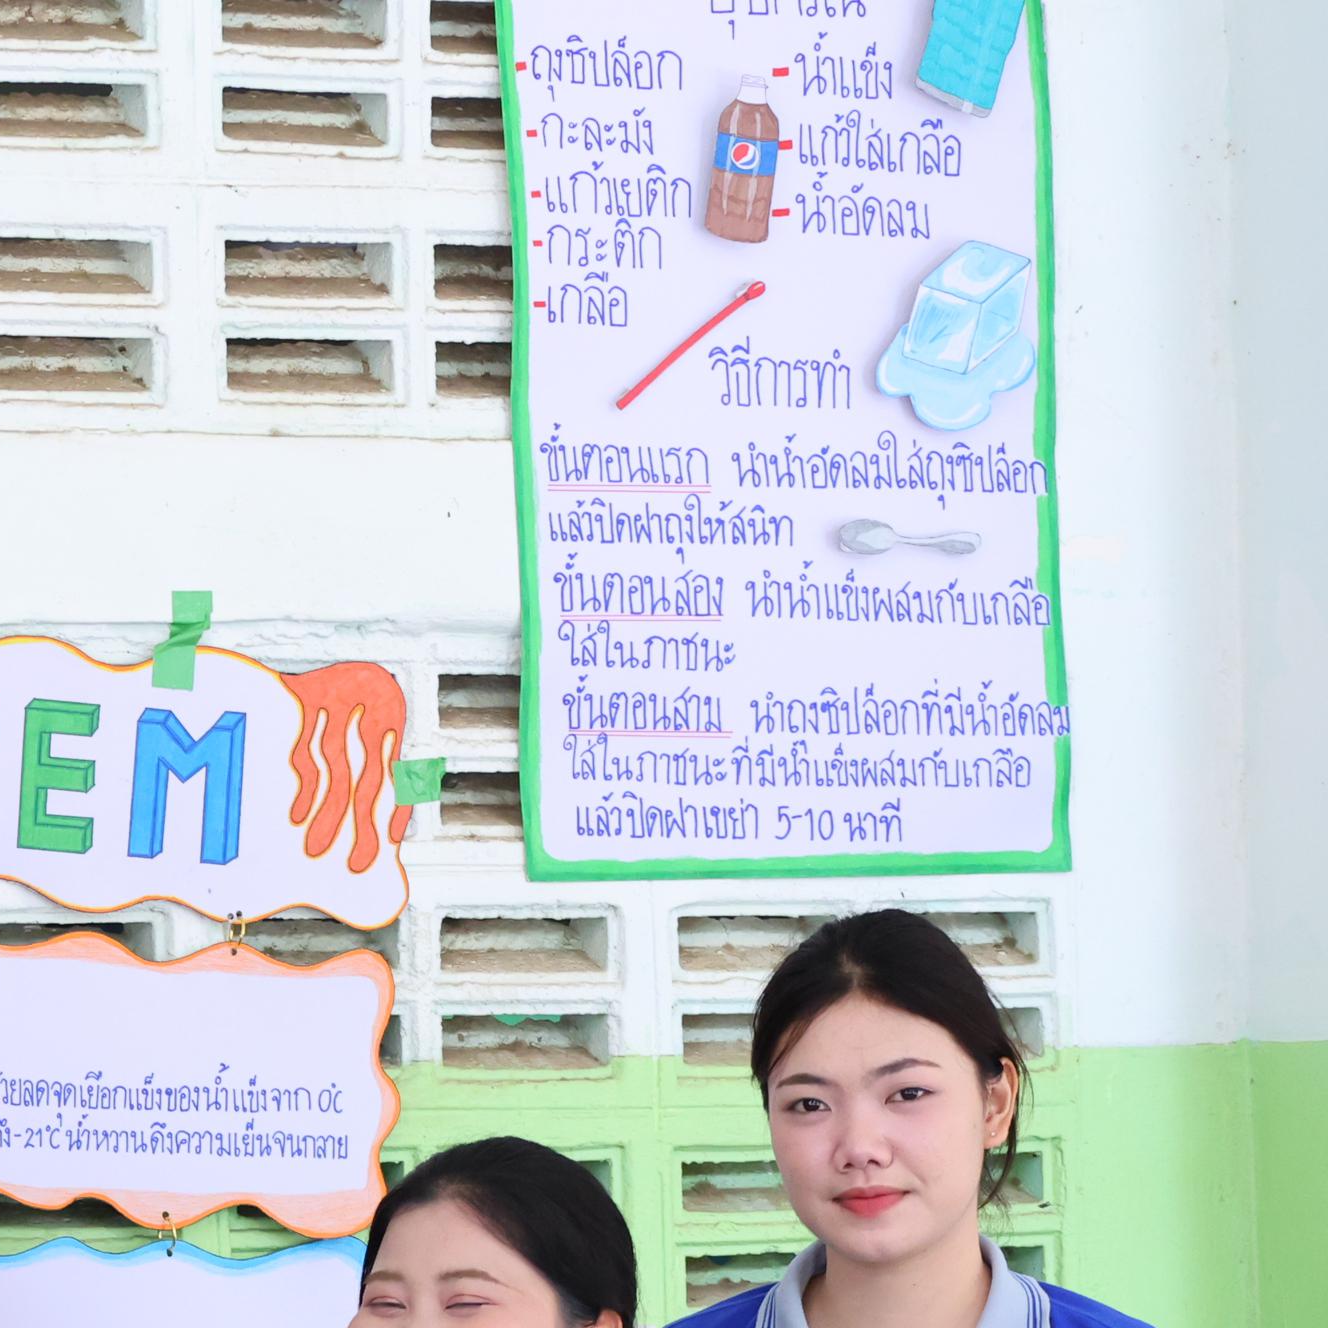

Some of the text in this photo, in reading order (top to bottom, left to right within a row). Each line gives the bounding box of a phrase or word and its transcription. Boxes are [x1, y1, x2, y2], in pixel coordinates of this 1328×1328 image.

[530, 35, 683, 102] ถุงซิปล็อก
[794, 32, 893, 100] น้ำแข็ง
[540, 107, 654, 155] กะละมัง
[798, 109, 962, 177] แก้วใส่เกลือ
[795, 171, 931, 240] น้ำอัดลม
[547, 218, 662, 269] กระติก
[547, 272, 628, 327] เกลือ
[708, 335, 851, 408] วิธีการทำ
[774, 805, 834, 841] 5-10
[843, 798, 903, 843] นาที
